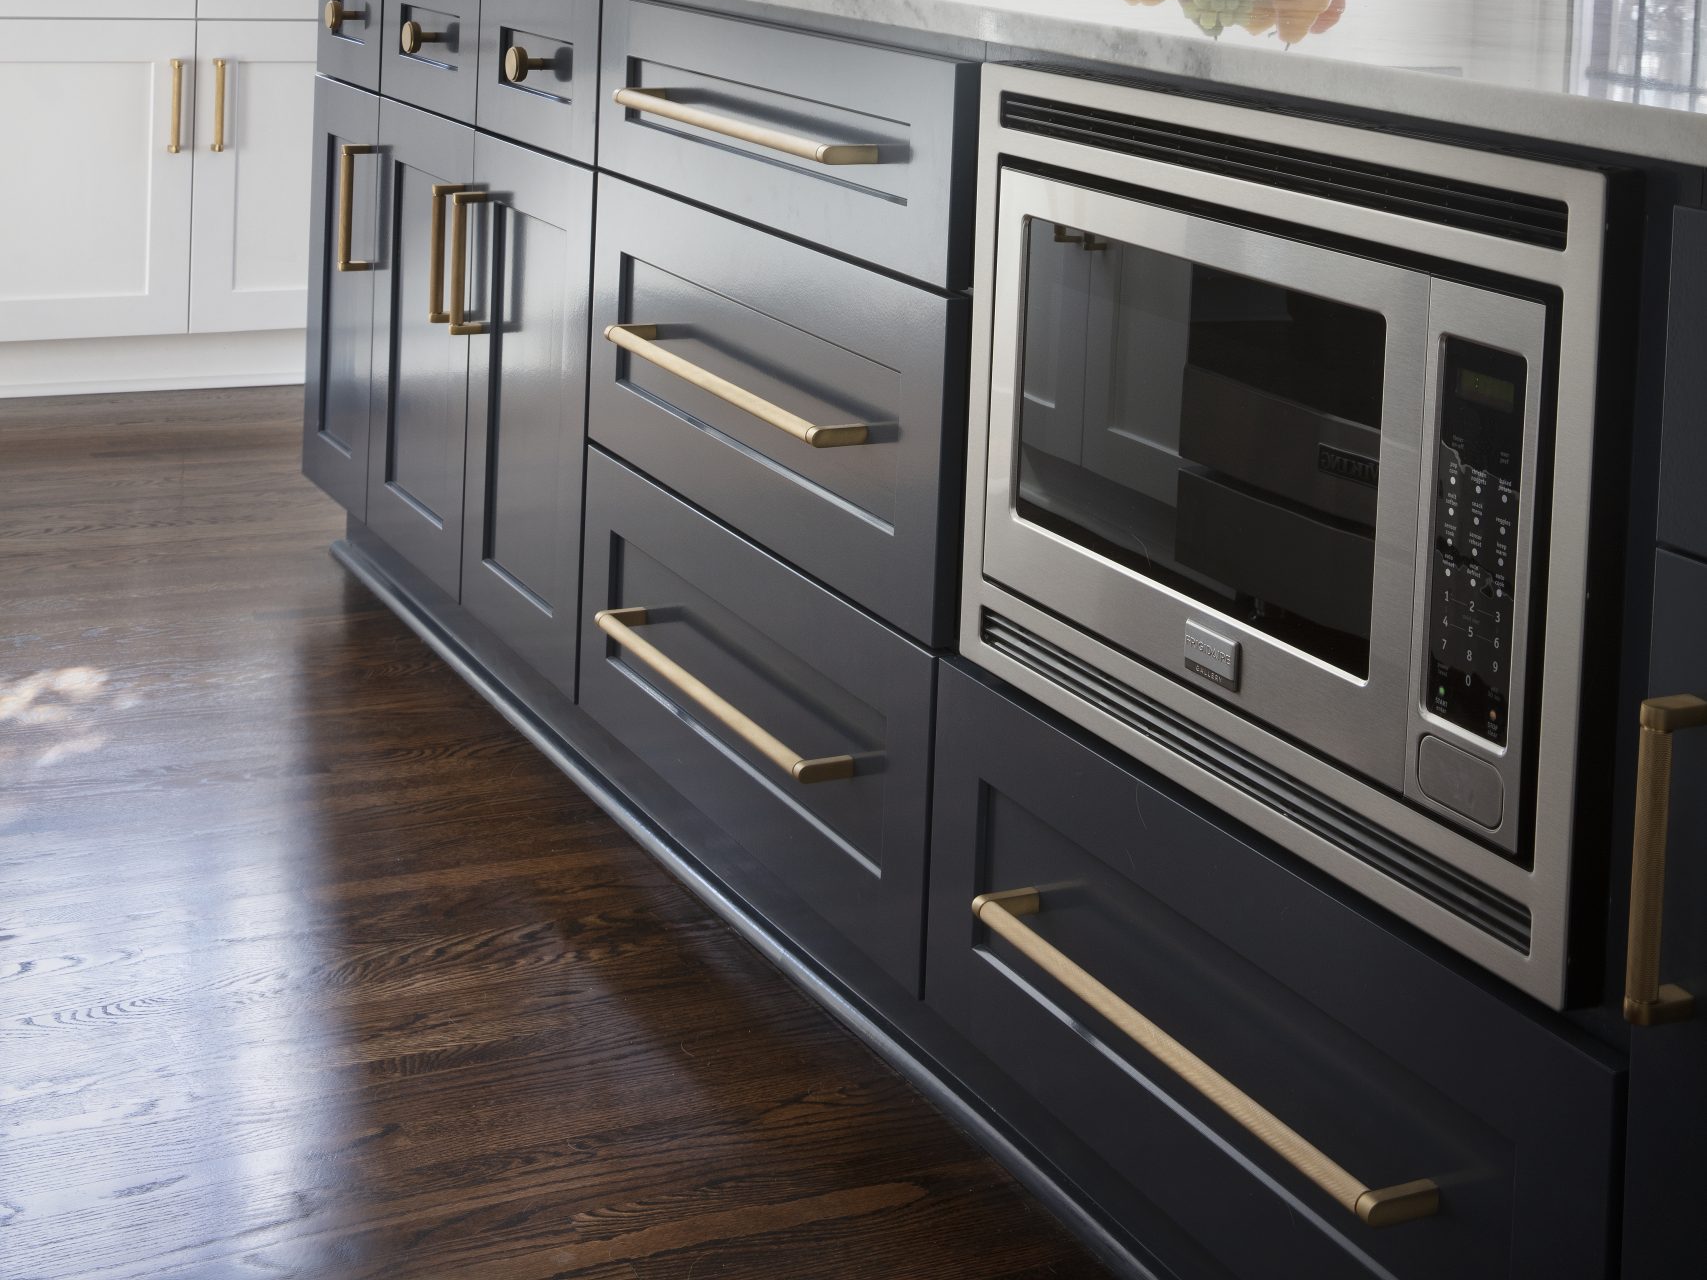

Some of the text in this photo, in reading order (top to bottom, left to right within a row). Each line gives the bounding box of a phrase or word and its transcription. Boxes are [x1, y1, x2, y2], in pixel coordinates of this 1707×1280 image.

[1444, 590, 1449, 602] 1
[1469, 601, 1475, 612] 2
[1442, 616, 1448, 627] 4
[1495, 611, 1500, 622] 3
[1468, 626, 1473, 637] 5
[1442, 638, 1447, 650] 7
[1494, 637, 1499, 648] 6
[1185, 634, 1231, 665] FRIGIDAIRE
[1467, 650, 1472, 661] 8
[1492, 661, 1498, 672] 9
[1195, 664, 1222, 682] GALLERY
[1465, 674, 1471, 686] 0
[1435, 696, 1448, 707] START
